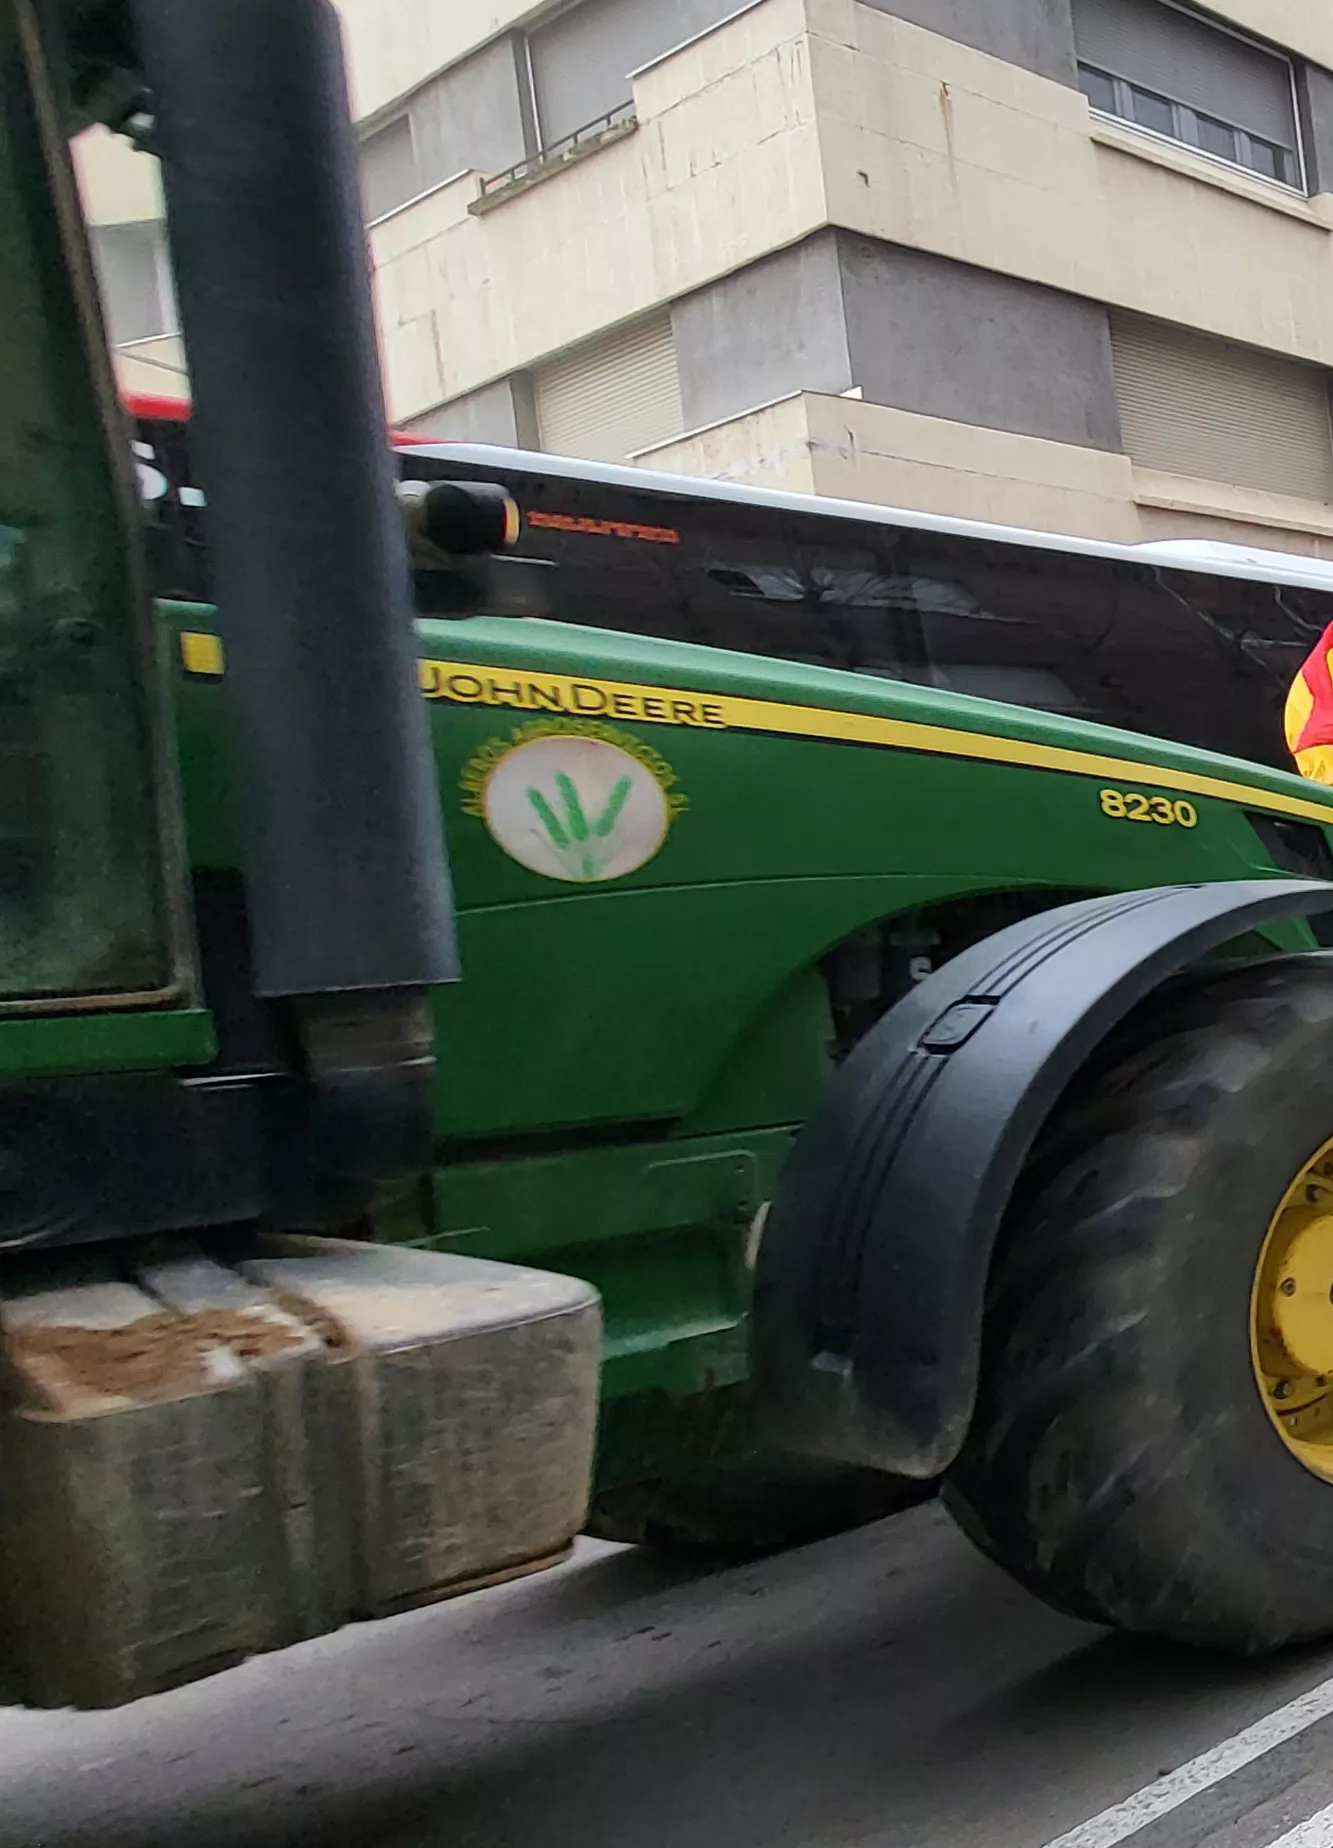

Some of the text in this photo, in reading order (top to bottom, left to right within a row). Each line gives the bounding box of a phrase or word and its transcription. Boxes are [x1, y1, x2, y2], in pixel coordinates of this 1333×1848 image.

[420, 666, 726, 727] JOHN DEERE
[1099, 788, 1199, 828] 8230
